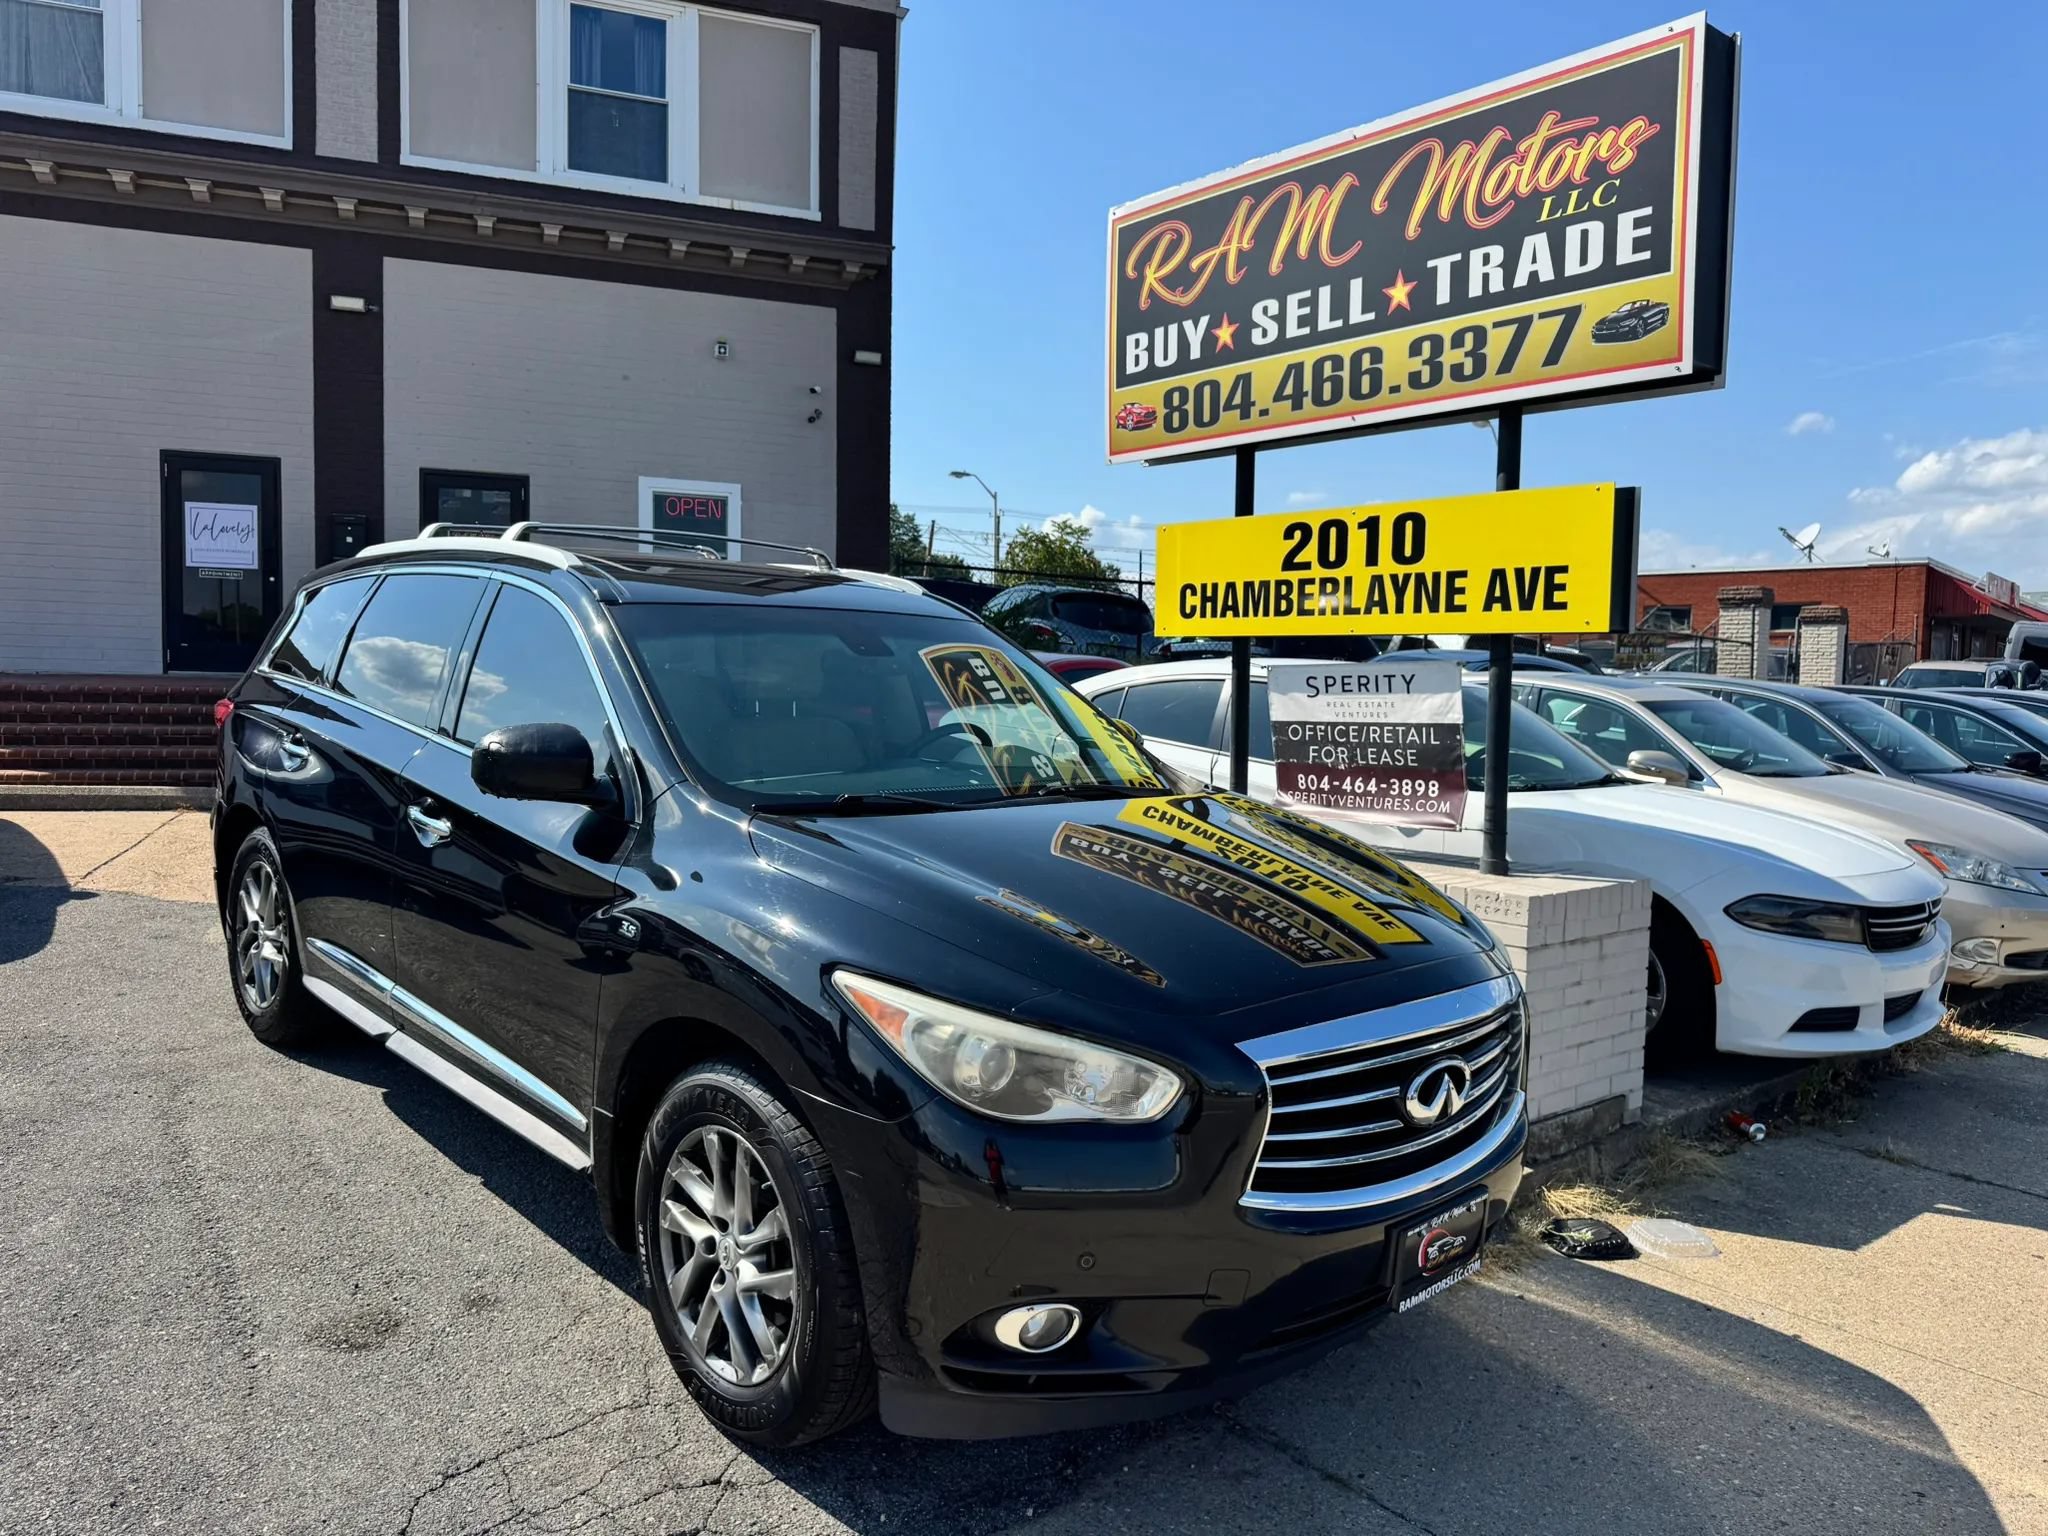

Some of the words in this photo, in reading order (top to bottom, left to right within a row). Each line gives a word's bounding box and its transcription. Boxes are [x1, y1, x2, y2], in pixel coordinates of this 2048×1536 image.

[1125, 172, 1362, 311] RAM
[1371, 110, 1660, 241] Motors
[1536, 178, 1620, 223] LLC
[1125, 314, 1210, 375] BUY
[1251, 276, 1375, 345] SELL
[1426, 206, 1653, 305] TRADE
[1163, 303, 1584, 434] 804.466.3377
[665, 496, 722, 519] OPEN
[1280, 511, 1427, 572] 2010
[1178, 570, 1467, 620] CHAMBERLAYNE
[1482, 565, 1569, 612] AVE
[1305, 674, 1416, 698] SPERITY
[1288, 724, 1440, 745] OFFICE/RETAIL
[1309, 746, 1349, 764] FOR
[1357, 748, 1418, 766] LEASE
[1287, 791, 1450, 813] SPERITYVENTURES.COM
[1297, 774, 1440, 797] 804-464-3898
